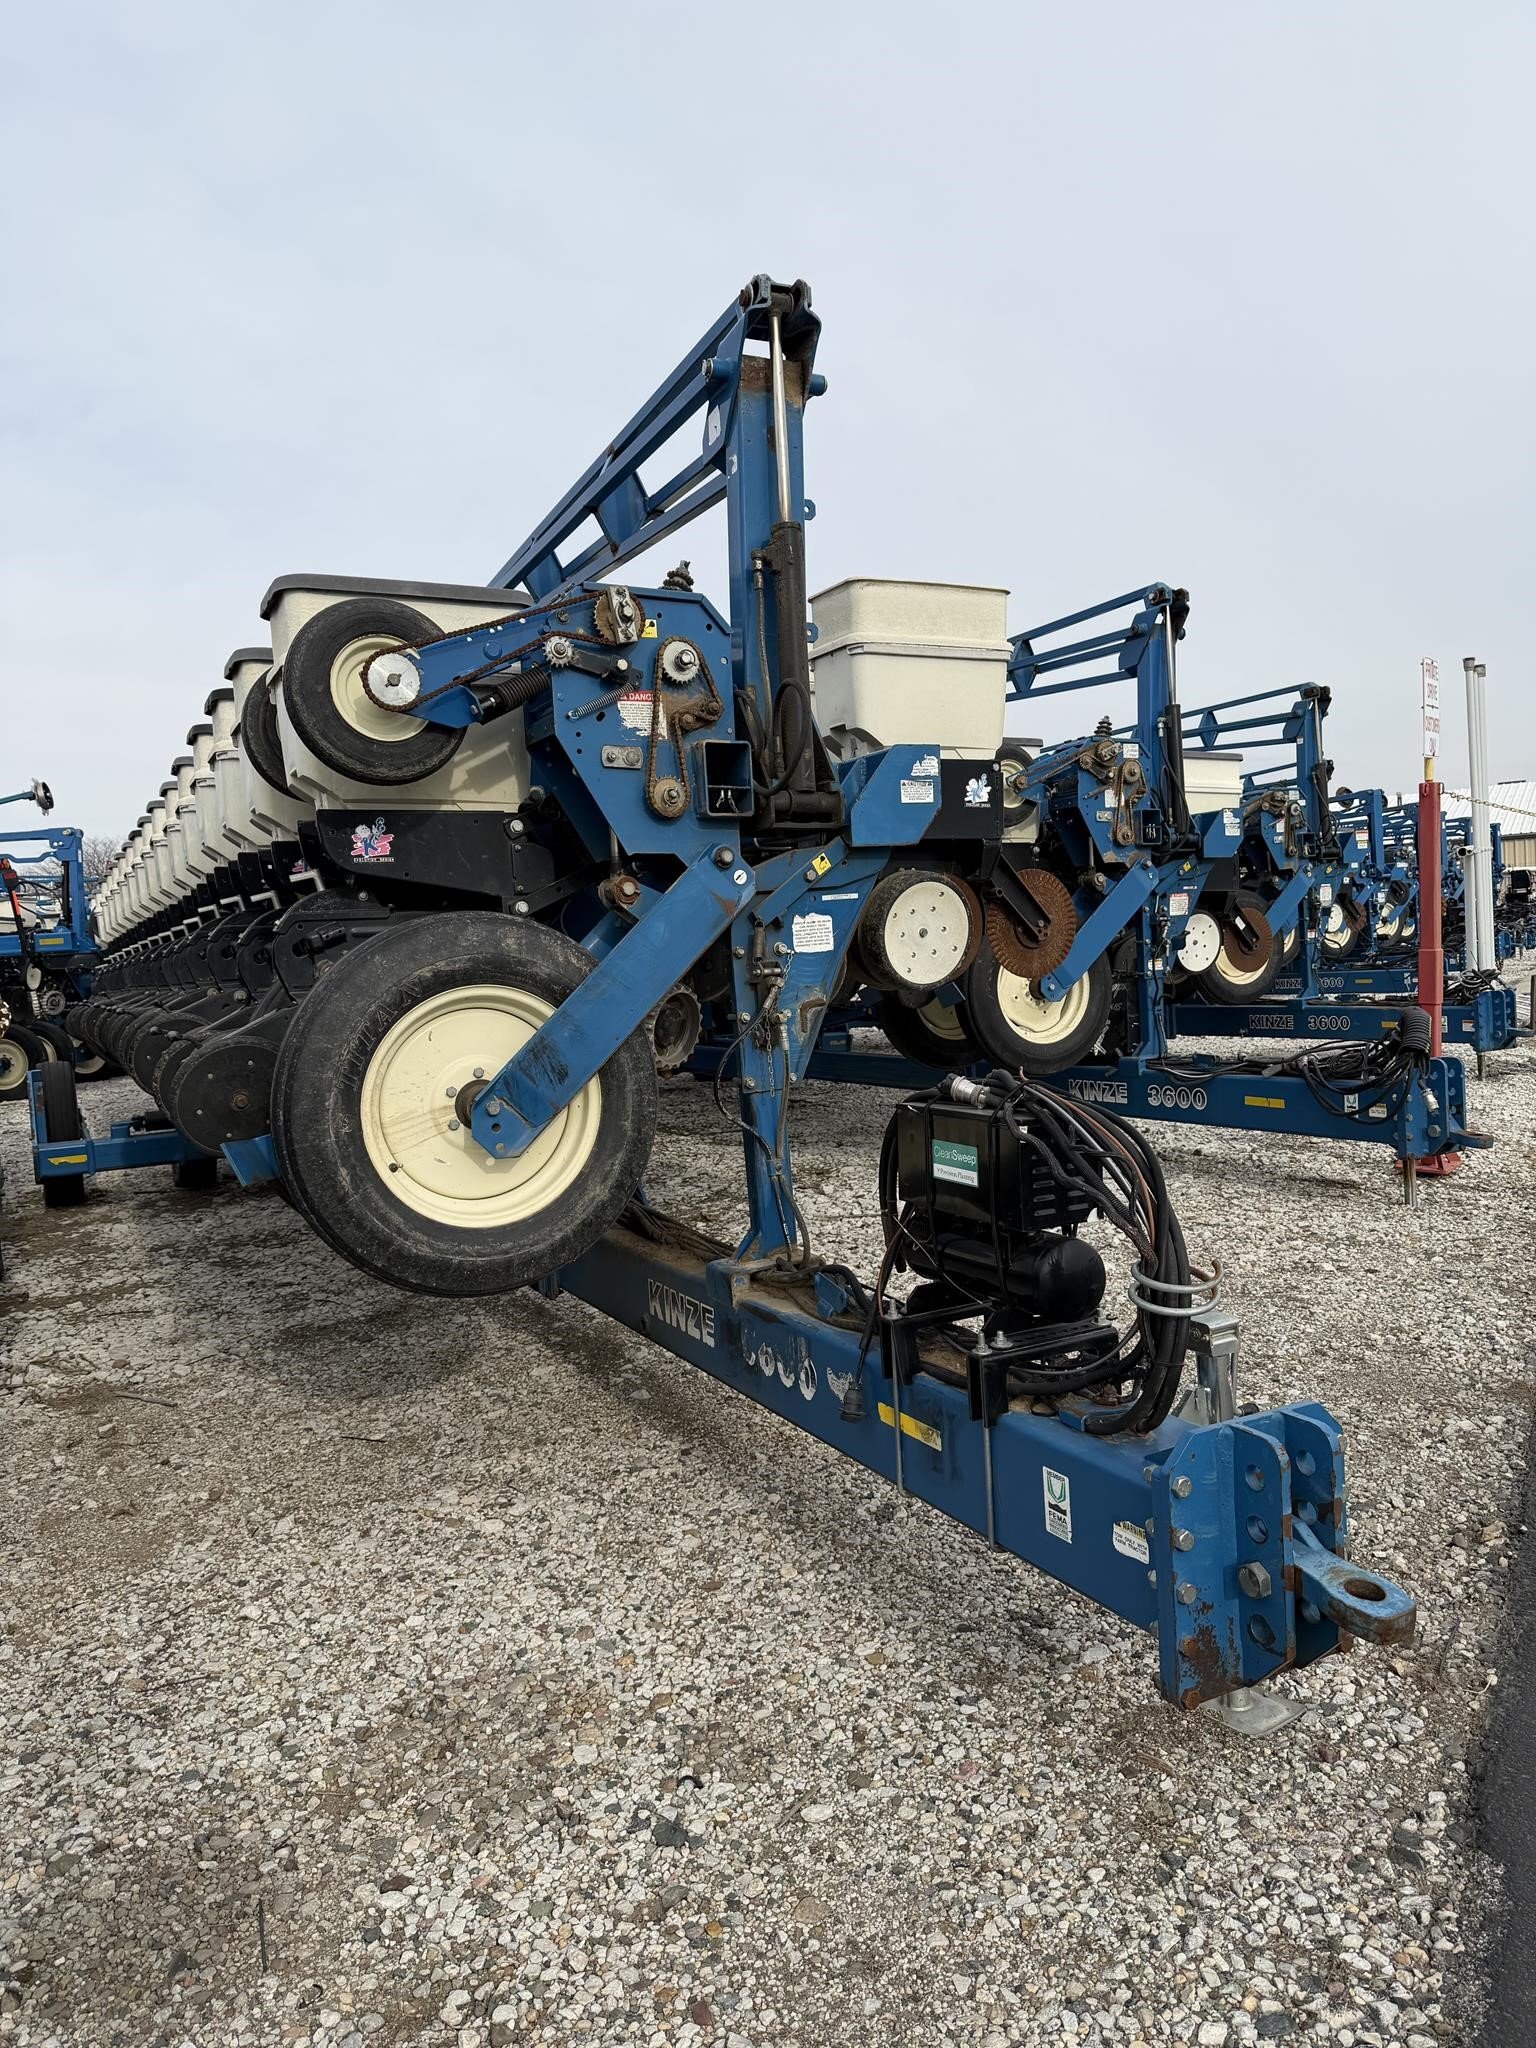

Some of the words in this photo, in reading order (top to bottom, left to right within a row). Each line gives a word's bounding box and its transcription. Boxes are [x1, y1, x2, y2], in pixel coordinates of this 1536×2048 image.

[629, 693, 654, 701] DANG
[1320, 977, 1344, 988] 600
[1250, 1015, 1294, 1030] KINZE
[1307, 1015, 1350, 1030] 3600
[336, 975, 422, 1092] TITAN
[1068, 1079, 1128, 1104] KINZE
[1148, 1085, 1207, 1110] 3600
[934, 1145, 976, 1167] CleanSweep
[648, 1278, 715, 1348] KINZE
[1047, 1470, 1066, 1482] MEMBER
[1049, 1510, 1068, 1526] FEMA
